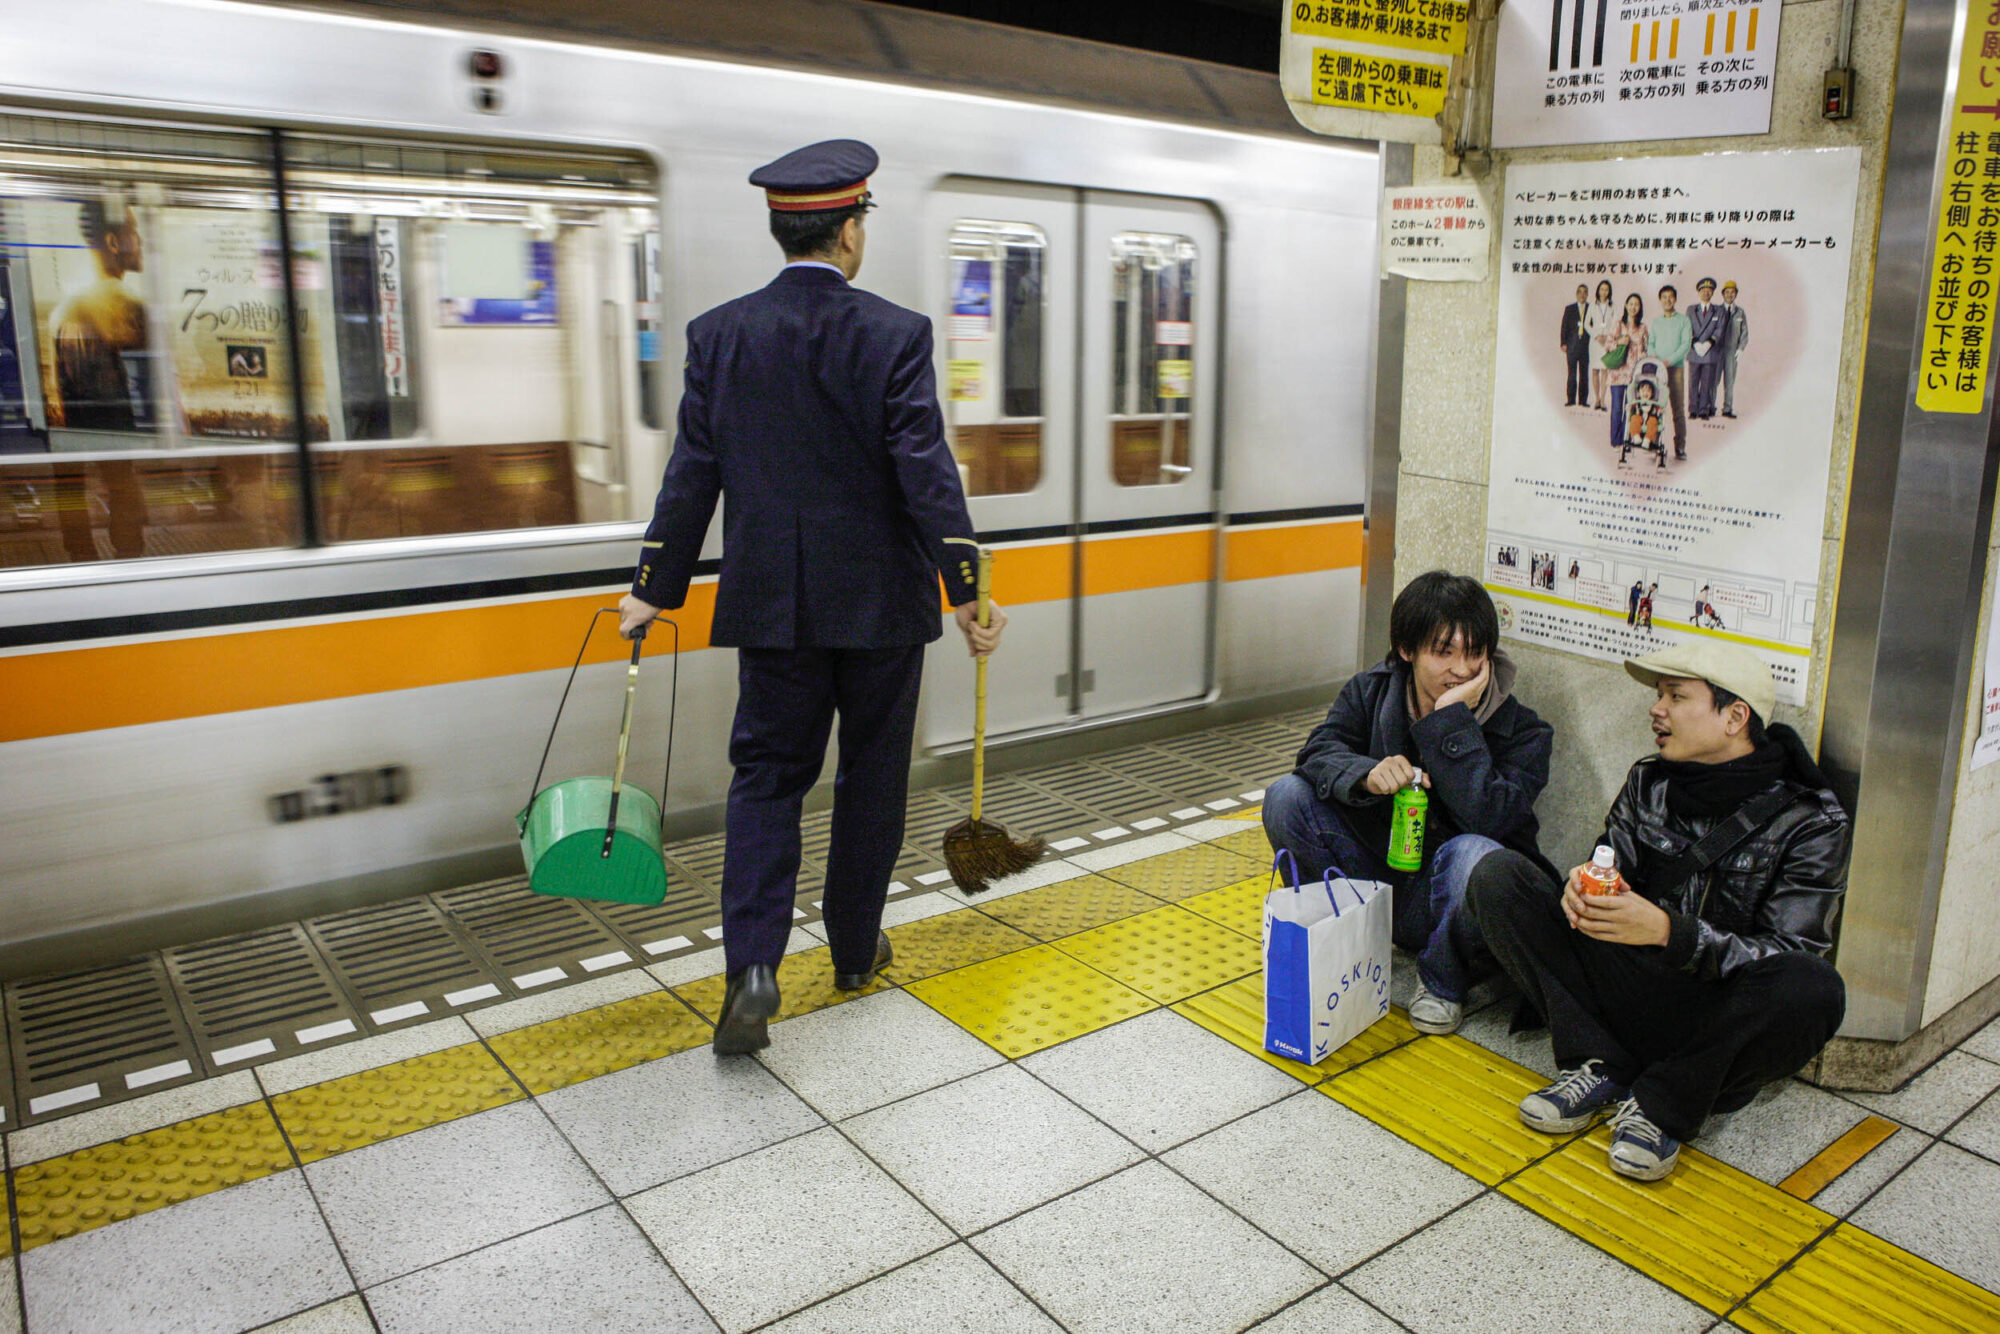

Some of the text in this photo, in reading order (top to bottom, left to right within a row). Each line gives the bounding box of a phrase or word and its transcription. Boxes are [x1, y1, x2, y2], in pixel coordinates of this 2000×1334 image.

[1296, 4, 1451, 42] の、お客様が乗り終るまで
[1319, 54, 1443, 88] 左側からの乗車は
[1619, 64, 1686, 83] 次の電車に
[1697, 57, 1755, 75] その次に
[1546, 72, 1604, 89] この電車に
[1695, 75, 1768, 96] 乗る方の列
[1317, 78, 1418, 110] ご遠慮下さい。
[1544, 90, 1605, 108] 乗る方の列
[1618, 82, 1685, 101] 乗る方の列
[1515, 187, 1690, 202] ベビーカーをご利用のお客さまへ。
[1513, 209, 1795, 226] 大切な赤ちゃんを守るために、列車に乗り降りの際は
[1512, 236, 1836, 250] ご注意ください。私たち鉄道事業者とベビーカーメーカーも
[1511, 262, 1683, 275] 安全性の向上に努めてまいります。
[1927, 131, 1981, 391] 柱の右側へお並び下さい
[1955, 131, 2000, 393] 電車をお待ちのお客様は
